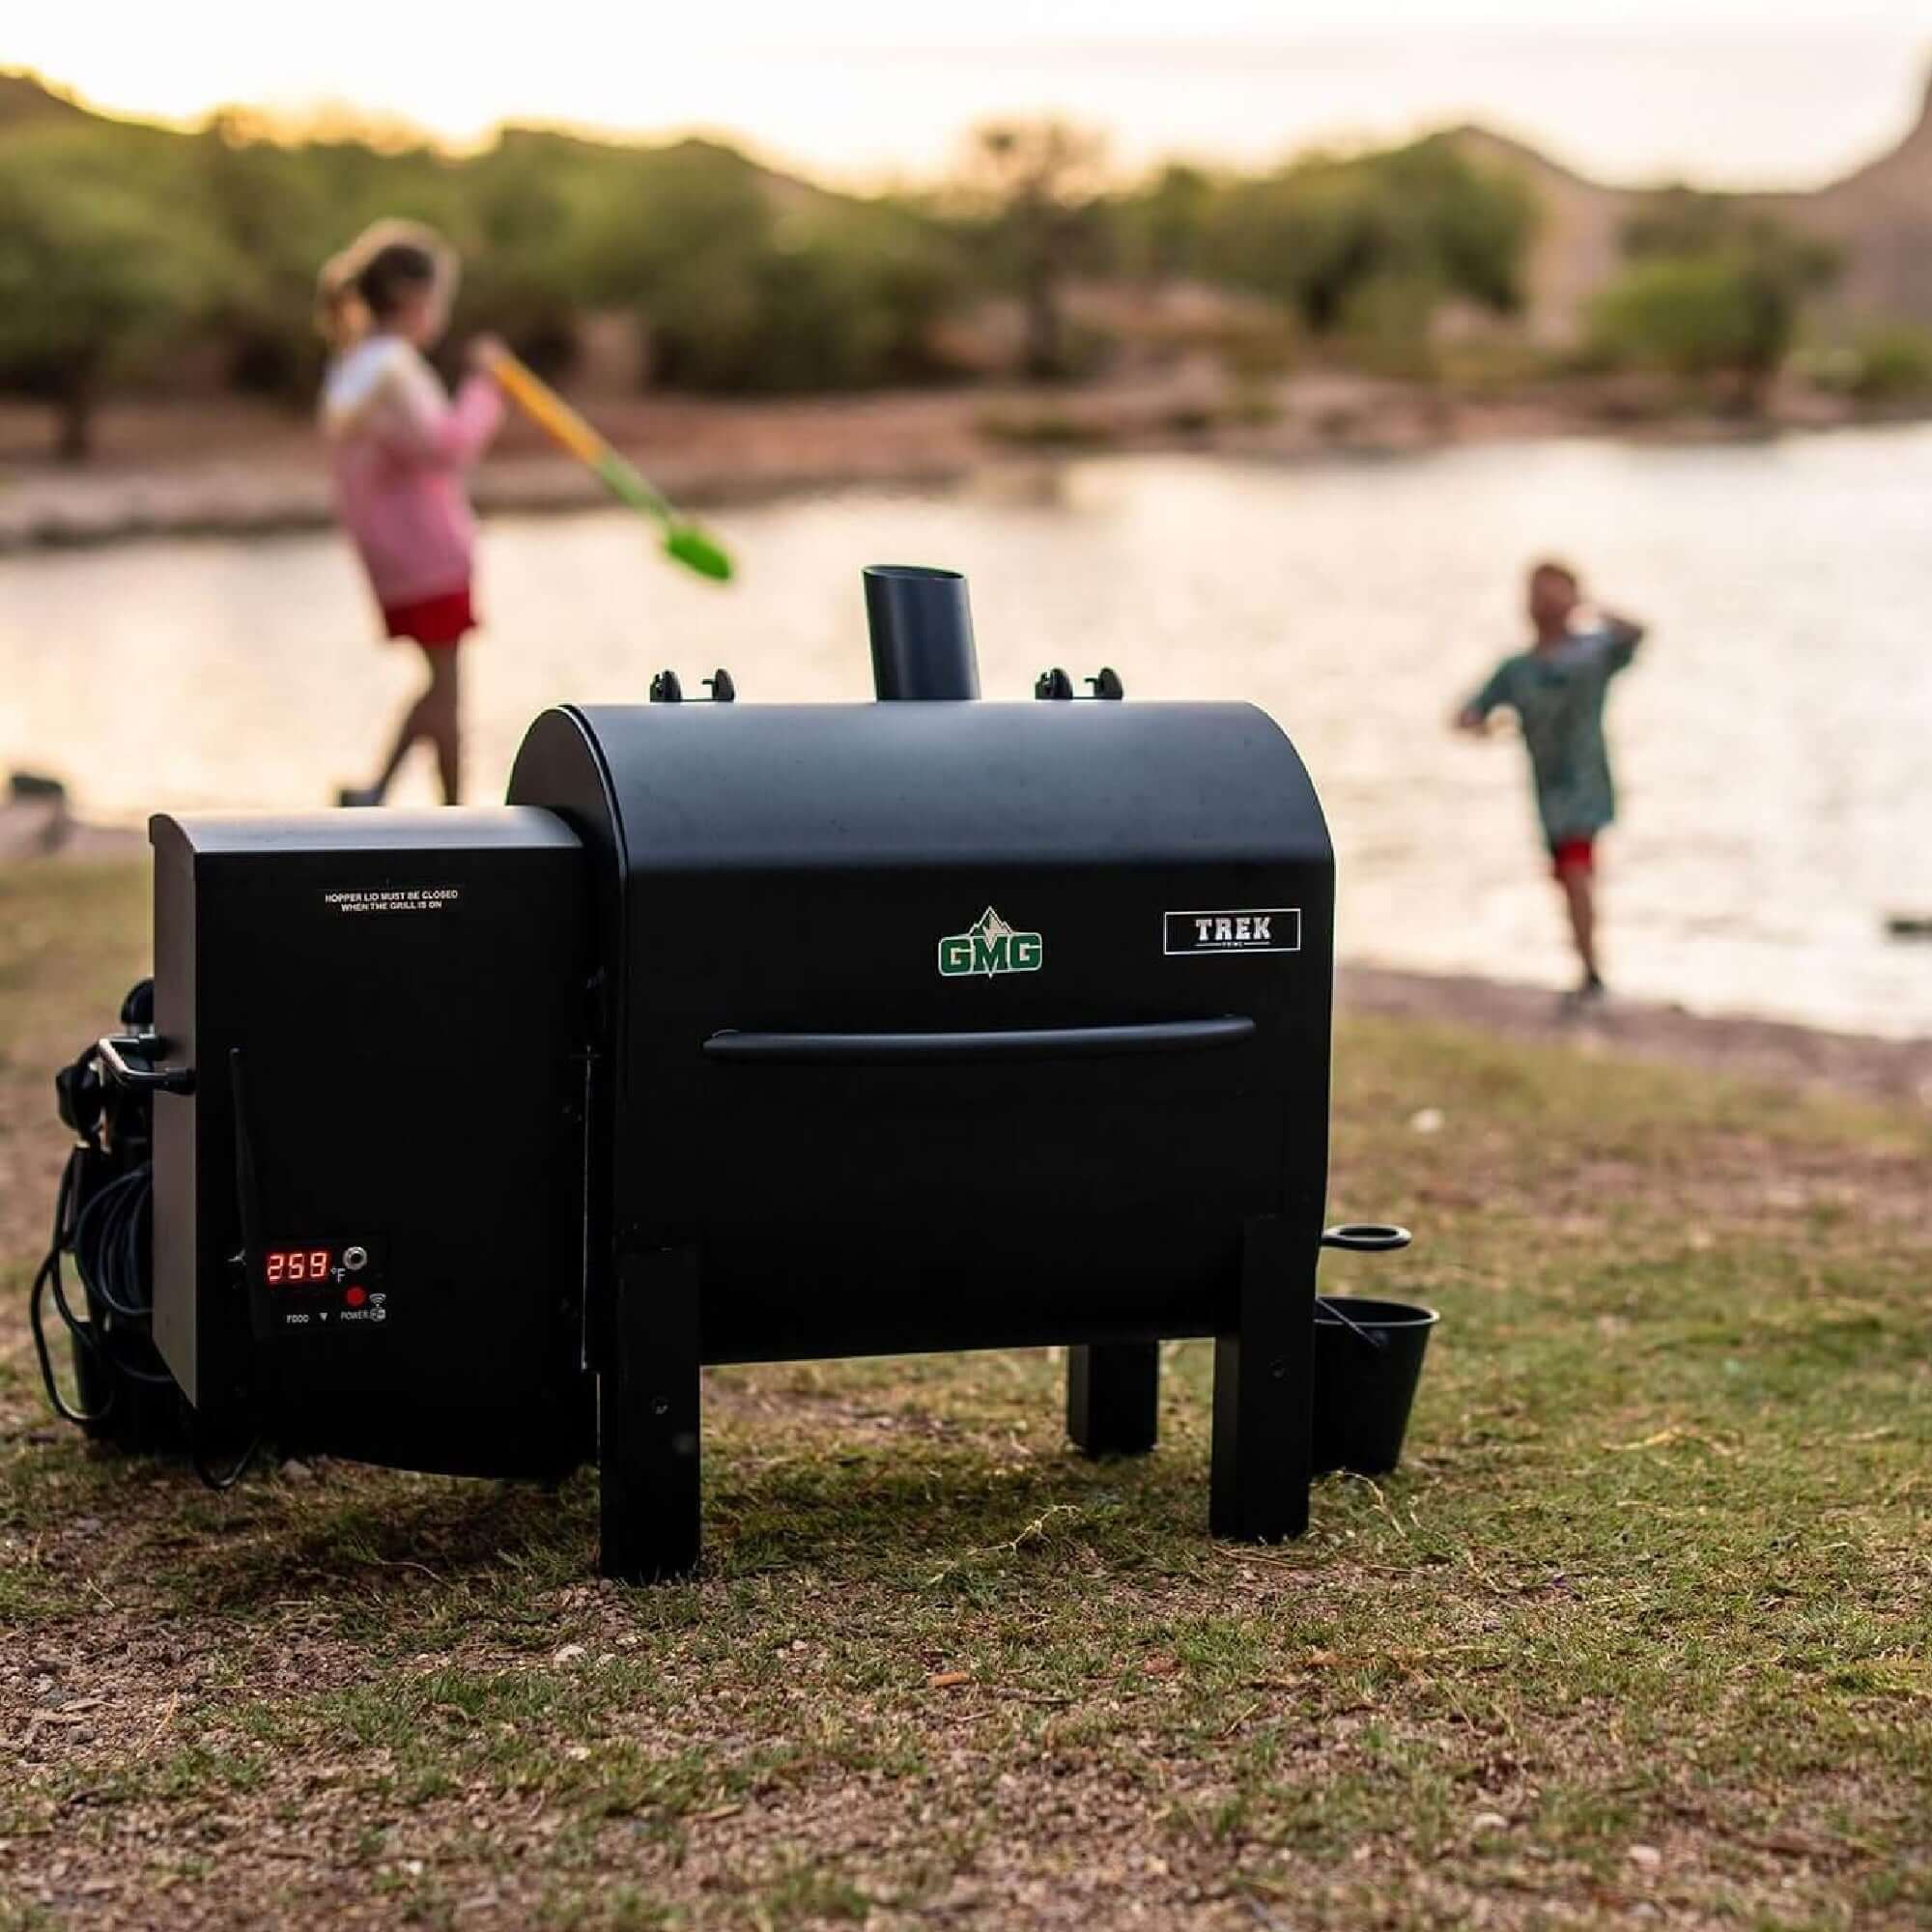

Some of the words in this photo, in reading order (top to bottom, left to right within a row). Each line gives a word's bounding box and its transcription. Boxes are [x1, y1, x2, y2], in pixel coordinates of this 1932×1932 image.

[325, 893, 362, 903] HOPPER
[364, 893, 380, 901] LID
[382, 892, 405, 900] MUST
[407, 891, 420, 900] BE
[422, 890, 459, 899] CLOSED
[341, 903, 369, 912] WHEN
[390, 901, 416, 910] GRILL
[428, 900, 442, 909] ON
[1195, 917, 1271, 941] TREK
[940, 930, 1042, 976] GMG
[268, 1252, 327, 1281] 259
